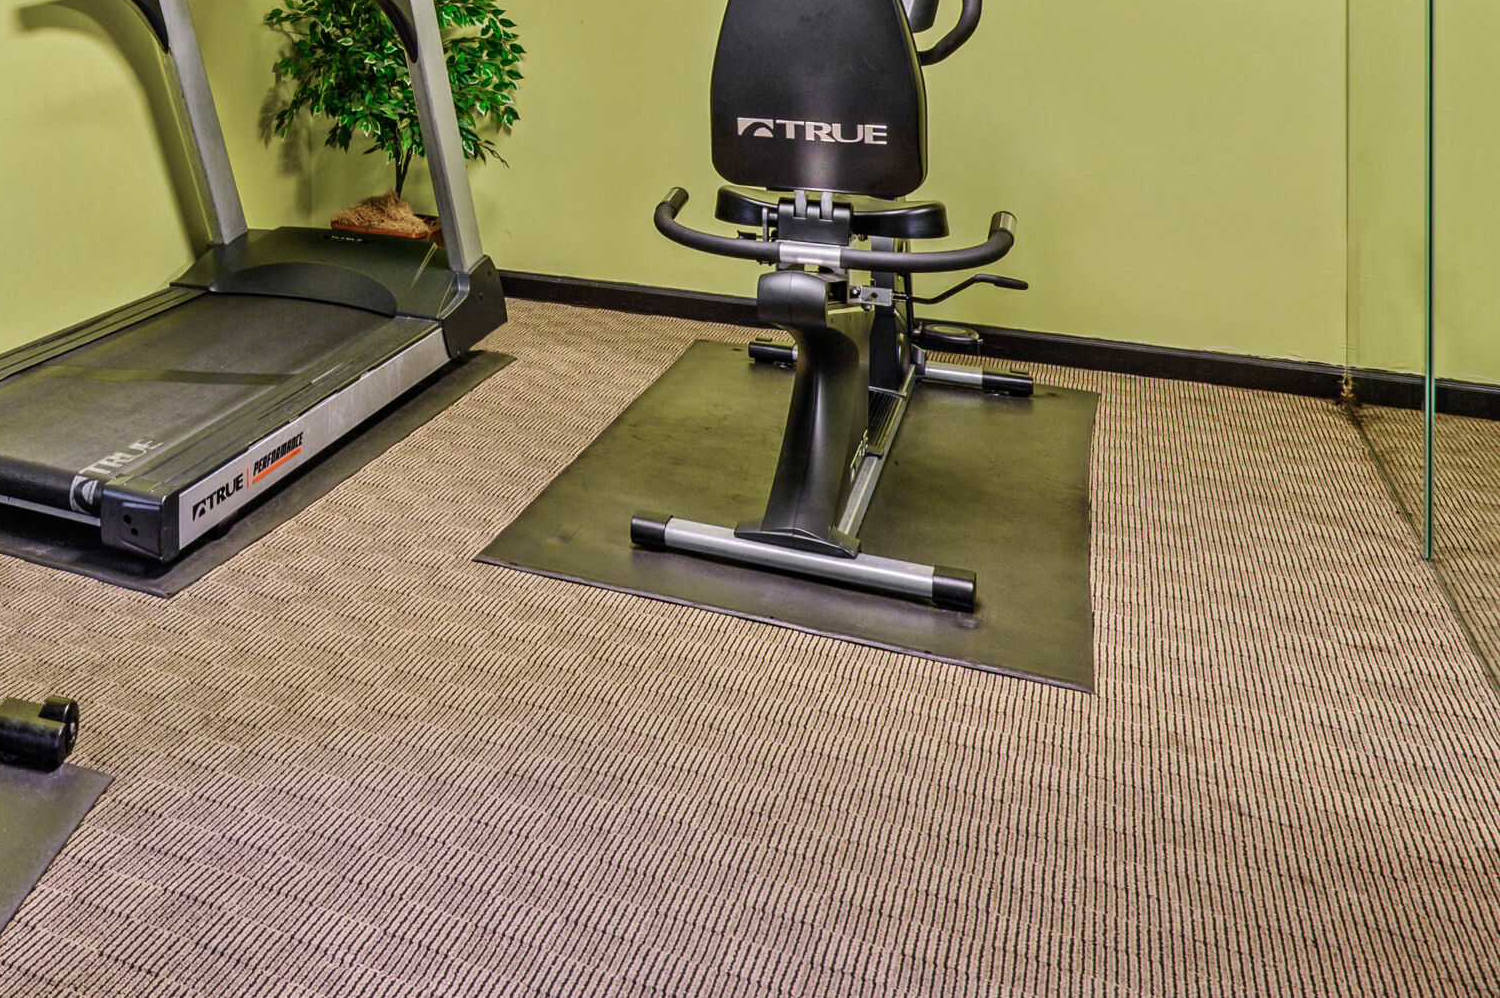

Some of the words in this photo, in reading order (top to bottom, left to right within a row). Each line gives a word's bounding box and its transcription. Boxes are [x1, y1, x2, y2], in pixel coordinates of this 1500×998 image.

[776, 120, 887, 144] TRUE
[78, 438, 164, 475] TRUE
[206, 473, 243, 510] TRUE
[253, 431, 303, 477] PERFORMANCE
